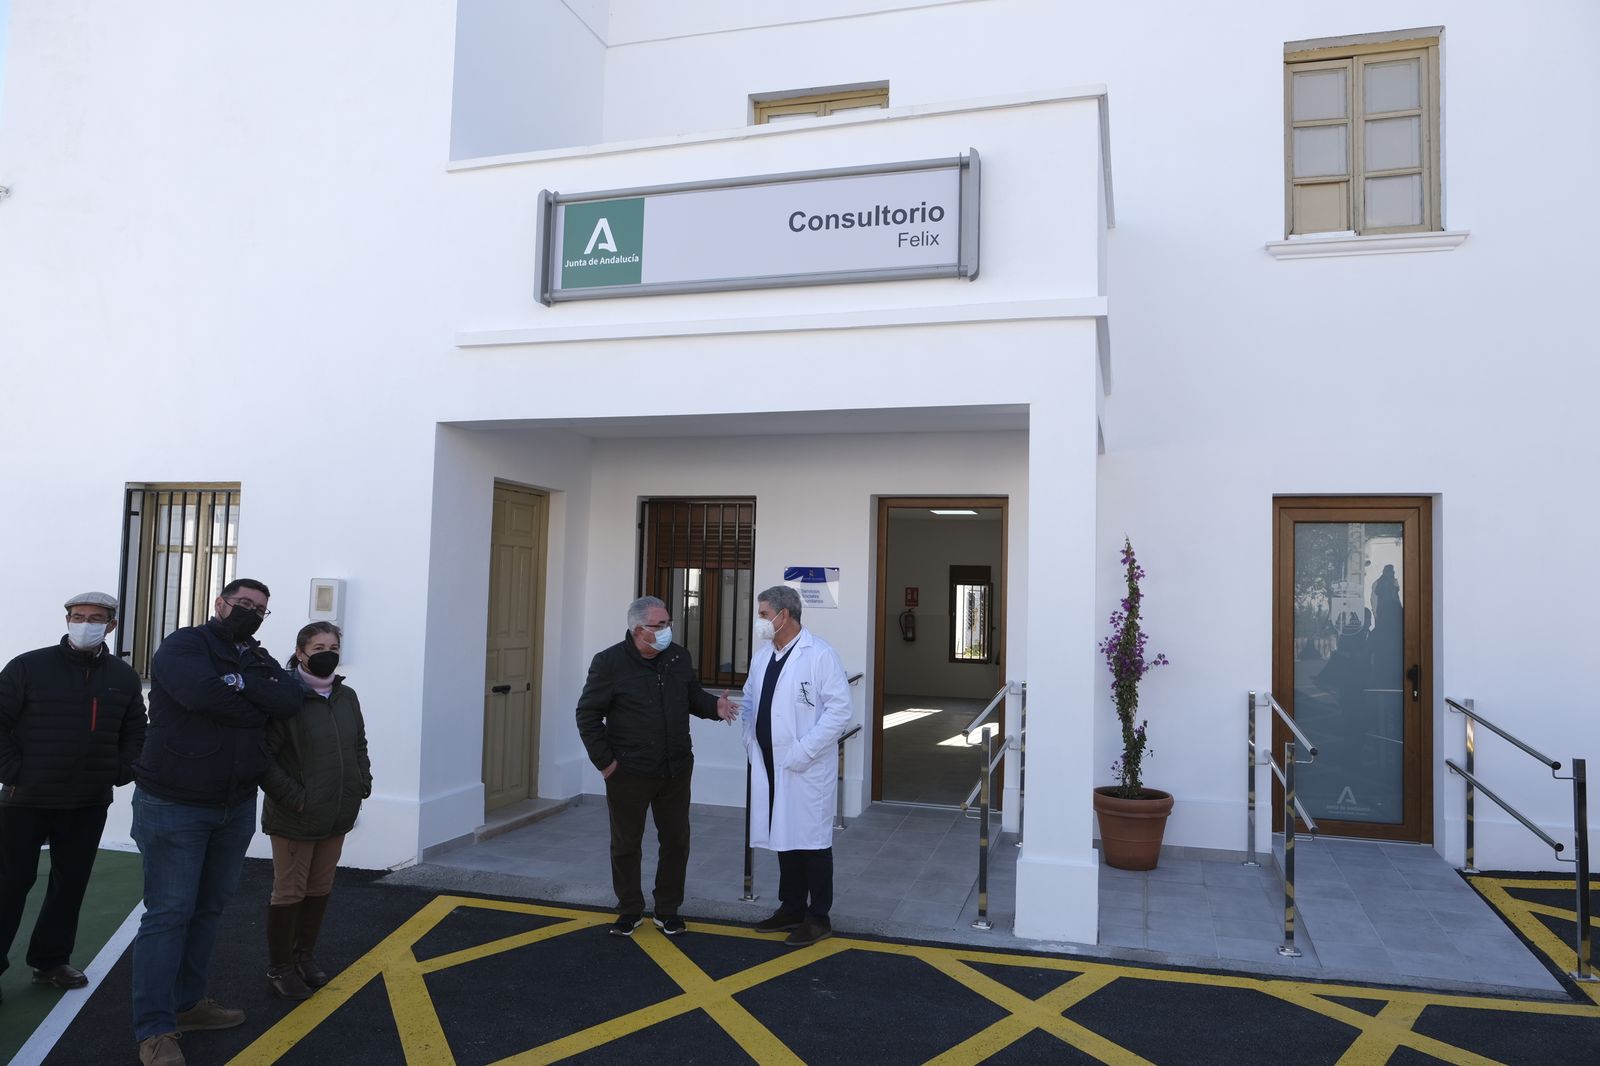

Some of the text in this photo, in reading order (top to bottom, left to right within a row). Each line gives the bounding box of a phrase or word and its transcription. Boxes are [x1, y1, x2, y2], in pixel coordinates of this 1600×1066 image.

[788, 201, 945, 232] Consultorio
[898, 231, 940, 248] Felix
[565, 253, 640, 268] Junta de Andalucía
